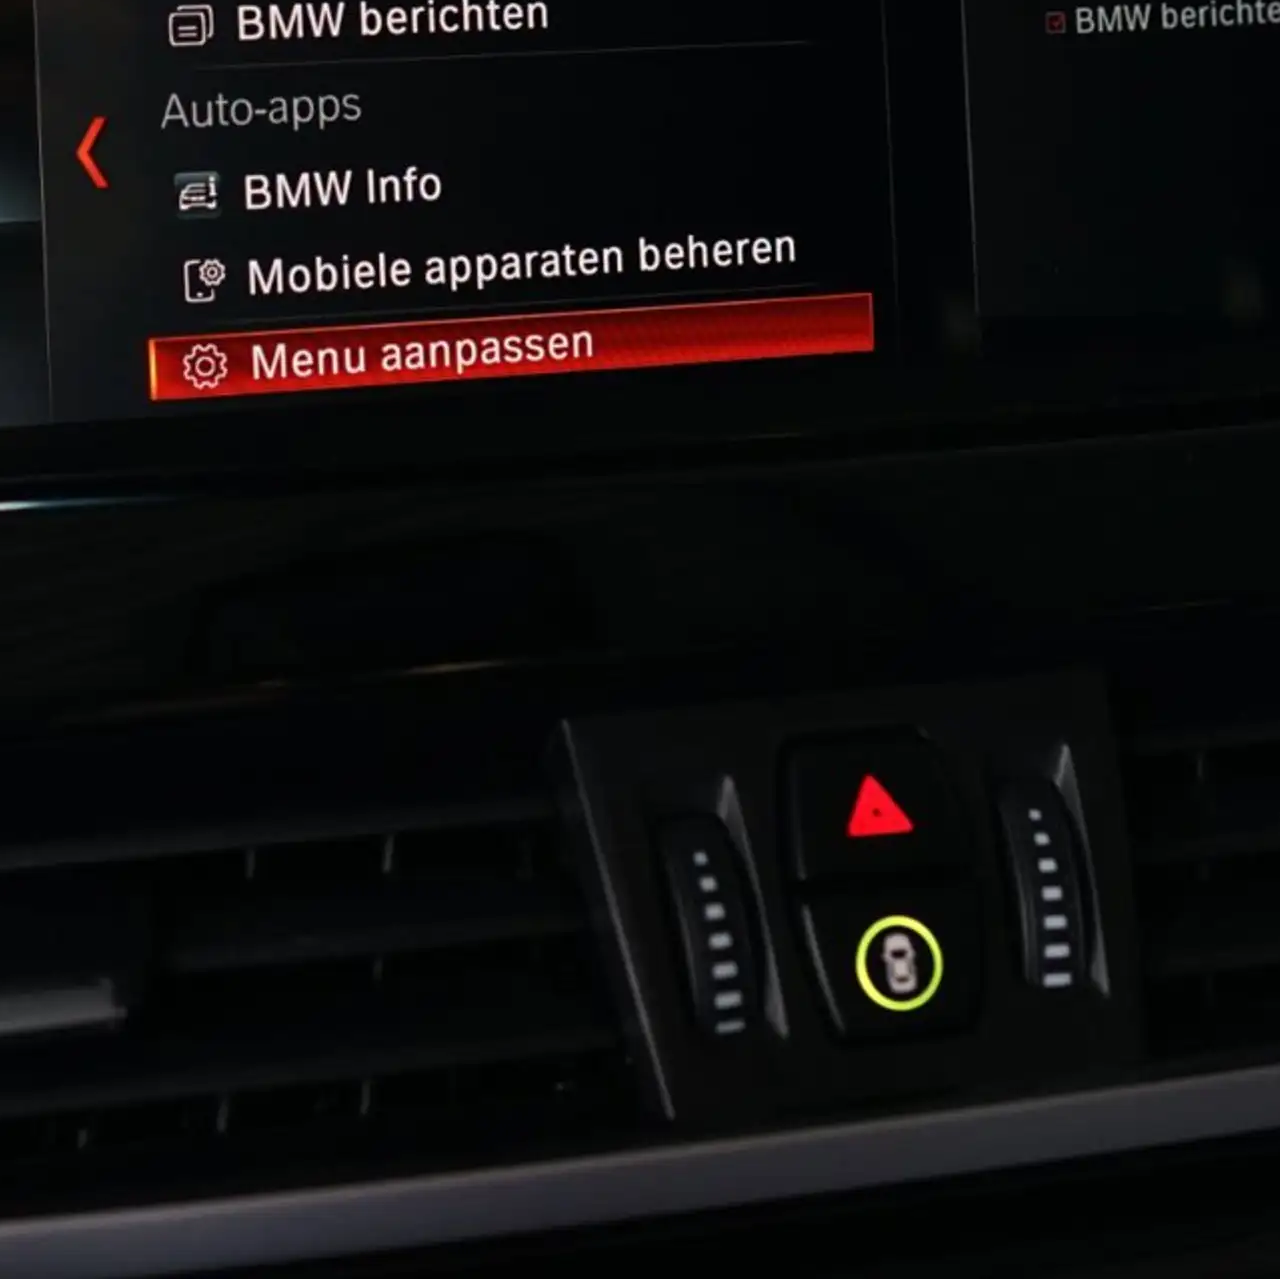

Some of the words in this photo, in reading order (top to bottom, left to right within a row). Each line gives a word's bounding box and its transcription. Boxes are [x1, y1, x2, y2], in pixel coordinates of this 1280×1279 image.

[237, 1, 345, 41] BMW
[1075, 3, 1151, 34] BMW
[160, 92, 362, 132] Auto-apps
[244, 169, 353, 210] BMW
[367, 166, 442, 204] Info
[248, 252, 412, 296] Mobiele
[425, 244, 623, 292] apparaten
[638, 234, 796, 272] beheren
[252, 342, 366, 380] Menu
[379, 328, 593, 375] aanpassen
